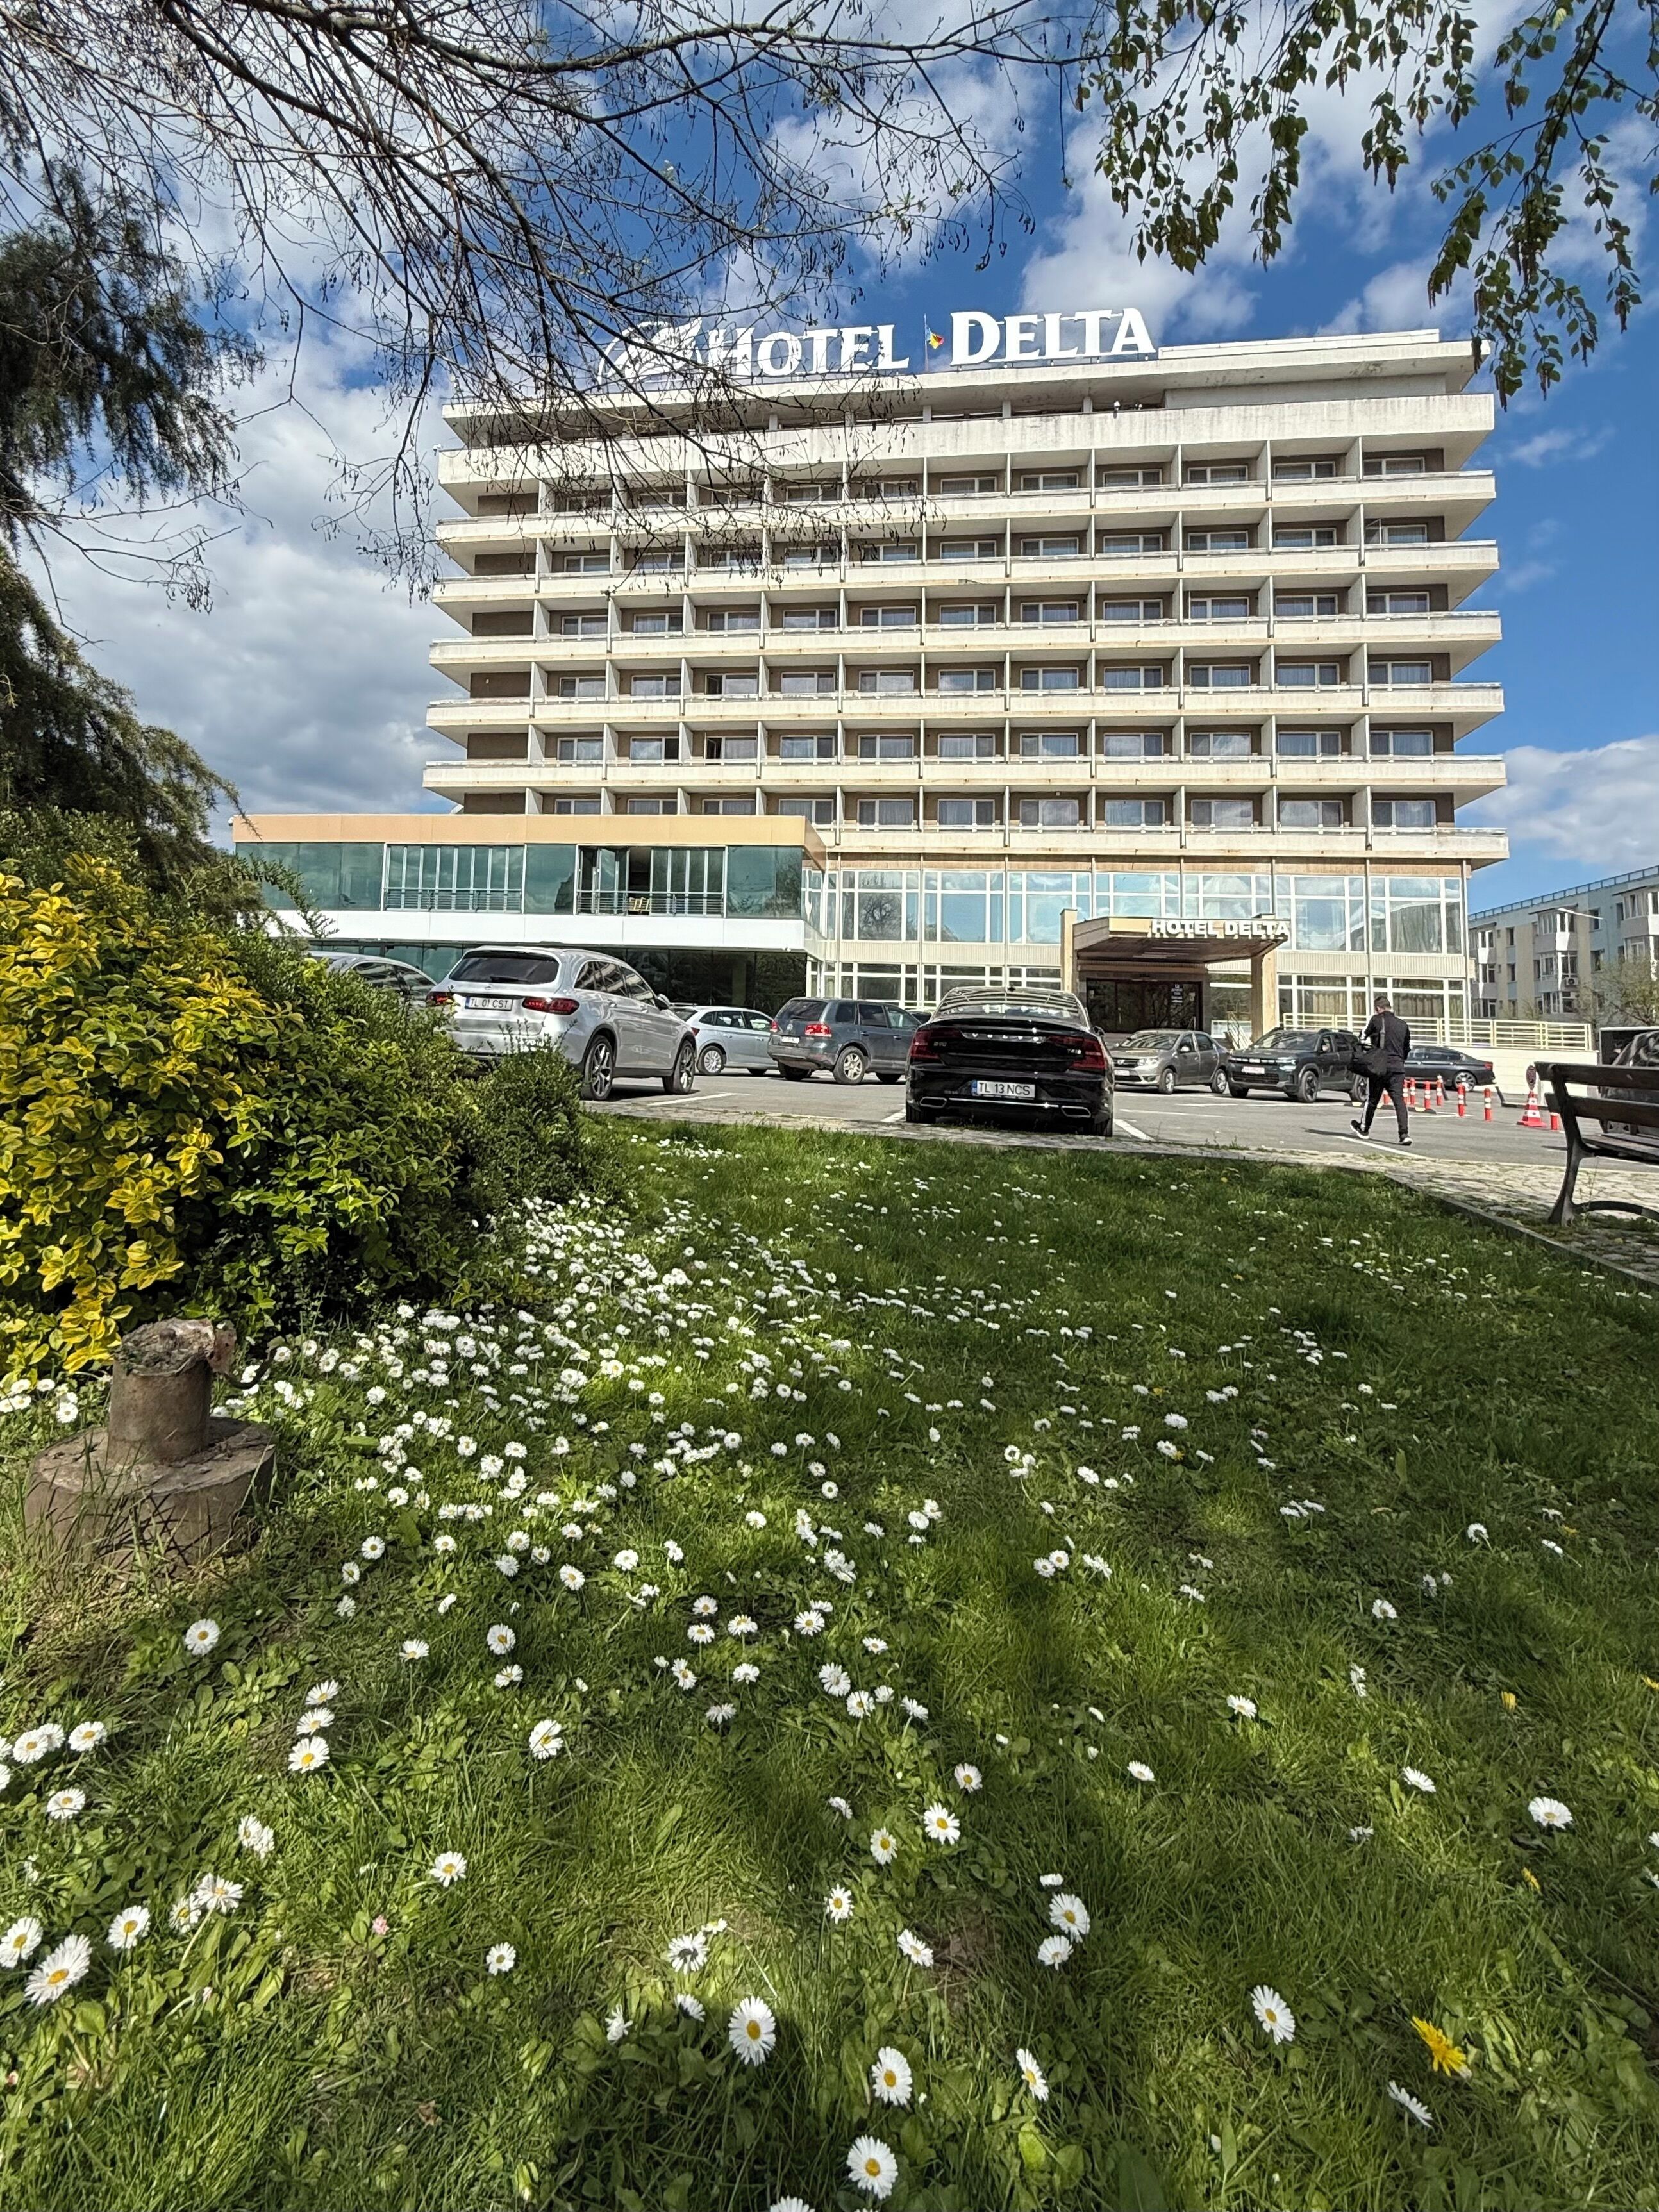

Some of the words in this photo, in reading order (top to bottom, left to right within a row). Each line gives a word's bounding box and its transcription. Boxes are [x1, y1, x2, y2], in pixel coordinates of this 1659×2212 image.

[706, 324, 910, 379] HOTEL
[950, 307, 1156, 366] DELTA
[1152, 919, 1217, 935] HOTEL
[1224, 920, 1290, 936] DELTA
[471, 998, 479, 1007] TL
[482, 999, 490, 1008] 01
[492, 999, 508, 1008] CST
[972, 1033, 1039, 1042] VOLVO
[979, 1082, 990, 1093] TL
[994, 1083, 1005, 1094] 13
[1006, 1084, 1030, 1095] NCS
